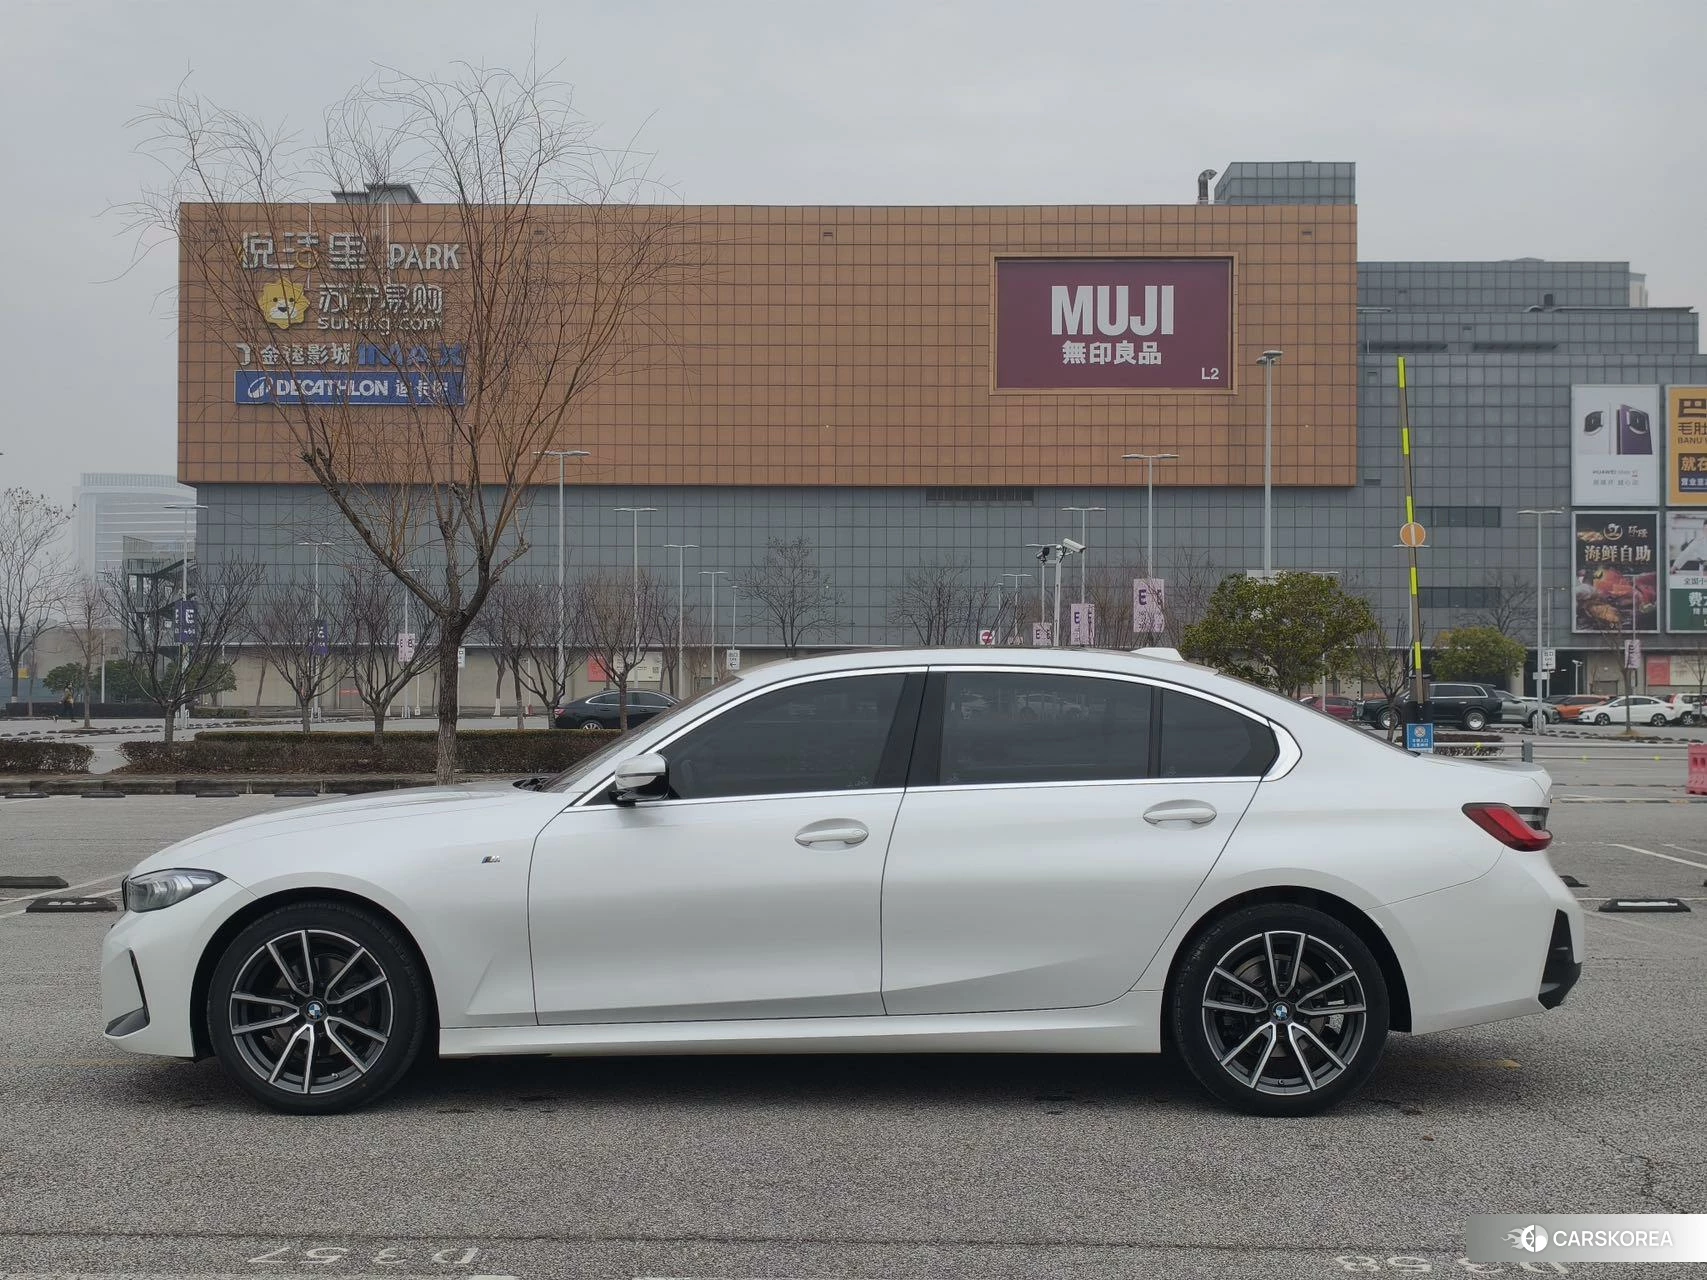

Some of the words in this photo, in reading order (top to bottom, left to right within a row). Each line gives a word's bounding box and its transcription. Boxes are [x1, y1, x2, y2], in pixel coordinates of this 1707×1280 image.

[389, 243, 459, 269] PARK
[1051, 285, 1174, 336] MUJI
[1062, 340, 1162, 365] 無印良品
[1201, 367, 1219, 380] L2
[276, 379, 389, 396] DECATHLON
[1584, 544, 1652, 562] 海鲜自助
[1138, 589, 1147, 606] E
